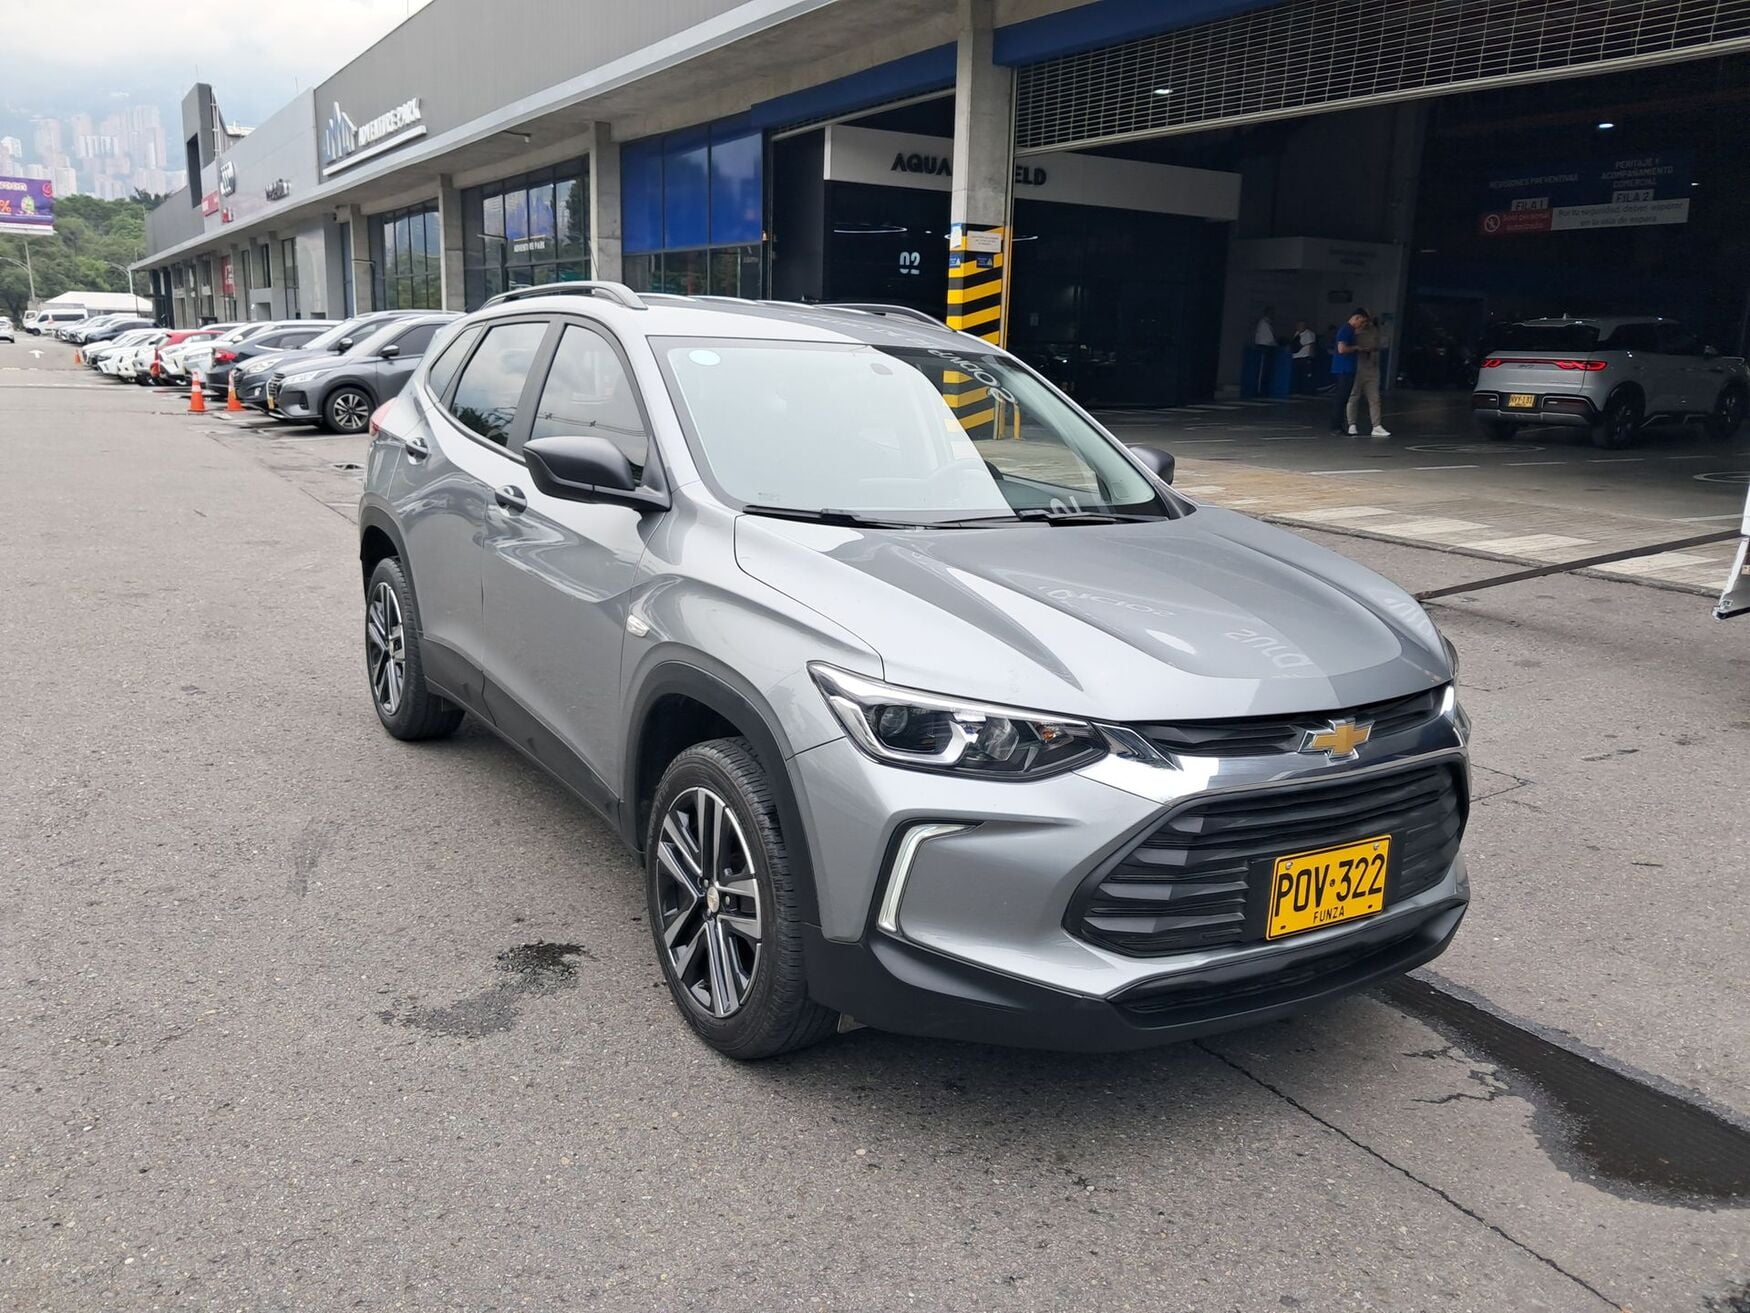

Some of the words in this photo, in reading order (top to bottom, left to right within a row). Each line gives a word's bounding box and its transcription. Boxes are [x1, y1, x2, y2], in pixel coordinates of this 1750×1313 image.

[891, 153, 952, 176] AQUA
[899, 251, 921, 275] 02
[1313, 905, 1345, 924] FUNZA
